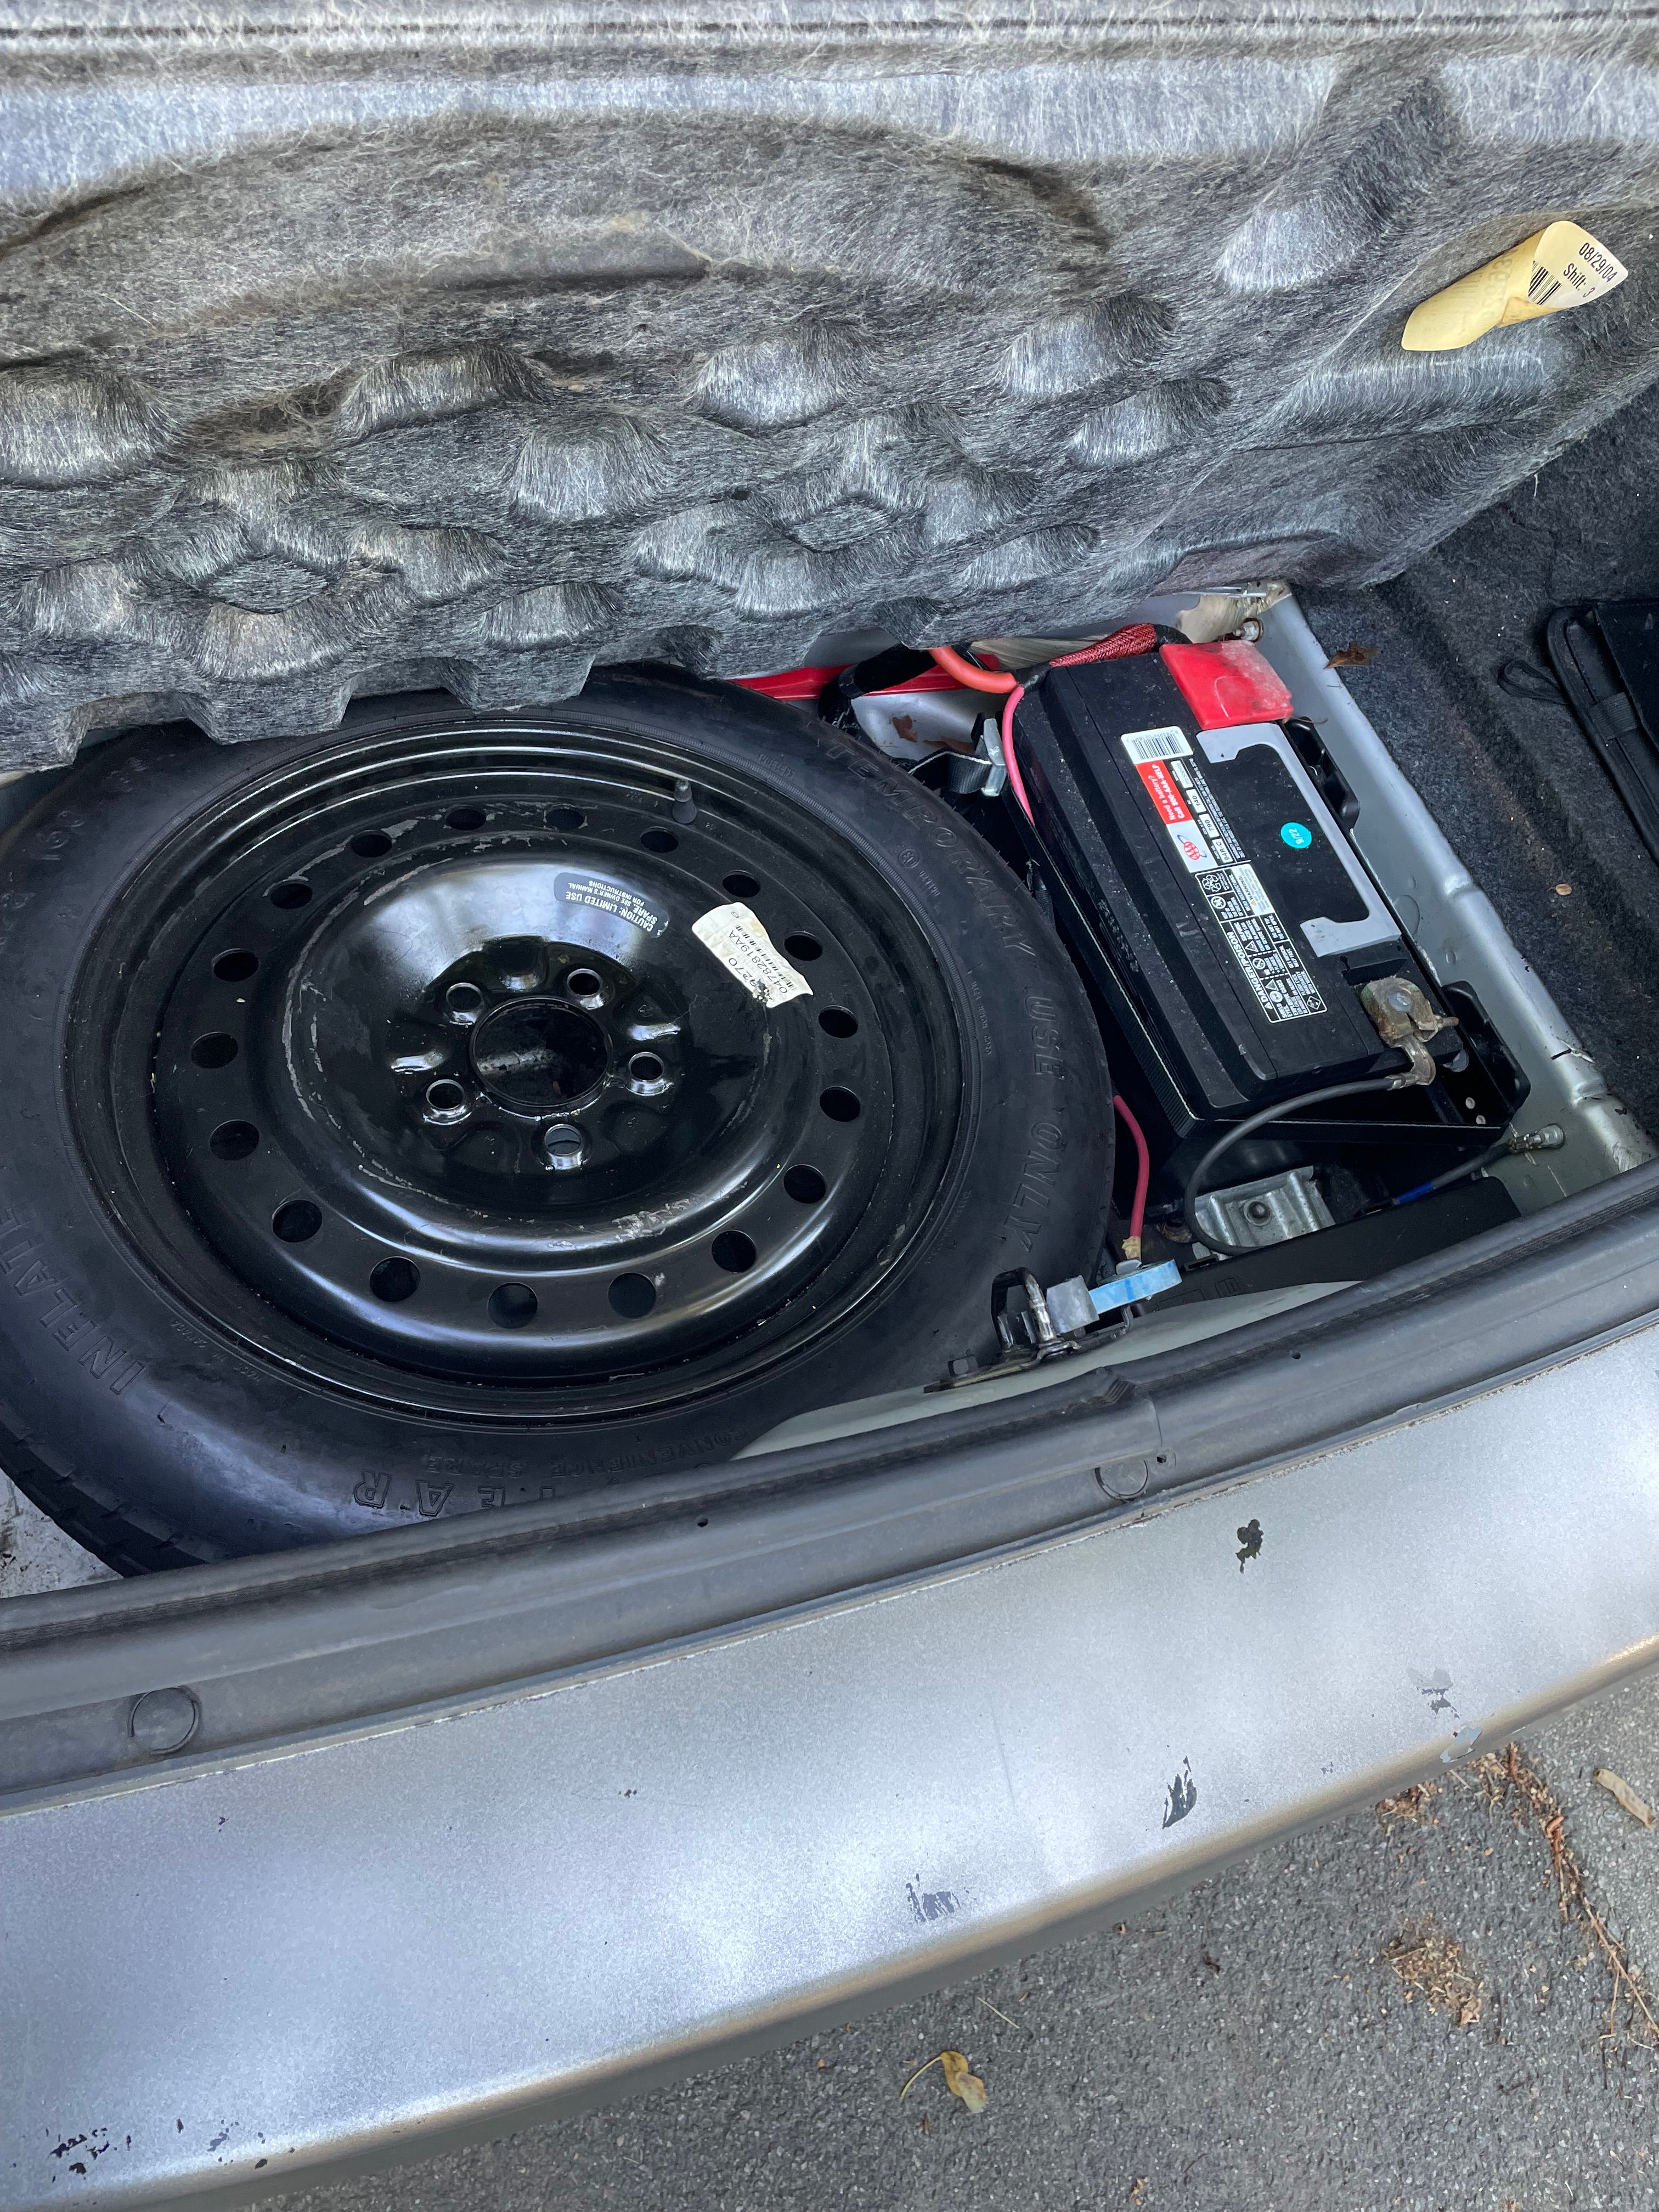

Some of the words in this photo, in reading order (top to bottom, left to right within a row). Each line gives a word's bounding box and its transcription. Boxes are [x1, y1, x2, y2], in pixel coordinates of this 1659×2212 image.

[1579, 242, 1617, 283] 08/29/04
[1564, 263, 1587, 291] Shift:
[1583, 287, 1594, 298] 3
[1148, 774, 1166, 798] battery?
[1151, 763, 1178, 806] 800-AAA-HELP
[1191, 795, 1201, 806] 140
[1163, 804, 1176, 820] Need
[1173, 806, 1185, 819] Call
[1204, 819, 1214, 831] 790
[1289, 828, 1305, 844] 9/22
[821, 737, 1036, 961] TEMPORARY
[1215, 841, 1230, 860] 94R-C
[566, 891, 582, 901] USE
[568, 883, 592, 893] MANUAL
[589, 881, 632, 900] INSTRUCTIONS
[594, 889, 620, 901] OWNER'S
[1237, 875, 1254, 900] WARNING:
[585, 896, 618, 912] LIMITED
[633, 896, 645, 906] FOR
[1242, 900, 1251, 911] READ
[619, 908, 653, 932] CAUTION:
[634, 904, 657, 924] SPARE.
[729, 930, 787, 993] 04782819AA
[1226, 931, 1269, 1002] DANGER/POISON
[1276, 979, 1287, 993] GASES
[1276, 1003, 1288, 1018] SHIELD
[1283, 993, 1299, 1015] EXPLOSIVE
[1020, 994, 1065, 1080] USE
[995, 1120, 1066, 1251] ONLY
[551, 1426, 748, 1477] CONVENIENCE
[424, 1454, 523, 1478] SPARE
